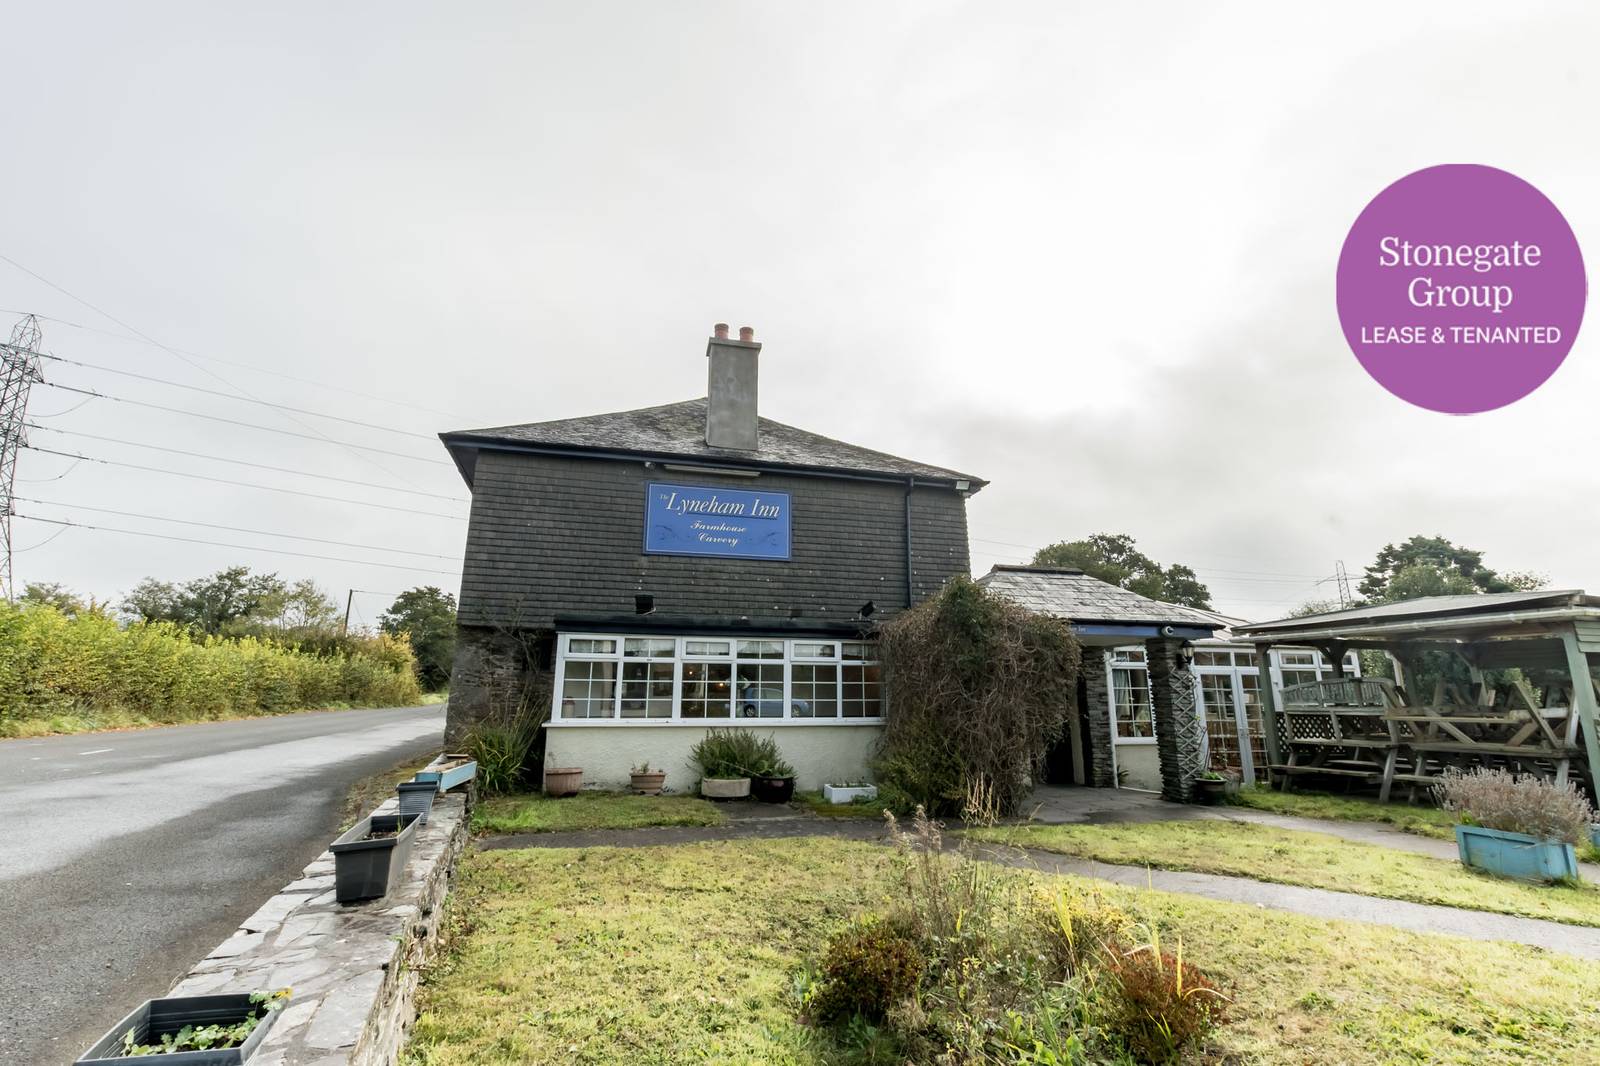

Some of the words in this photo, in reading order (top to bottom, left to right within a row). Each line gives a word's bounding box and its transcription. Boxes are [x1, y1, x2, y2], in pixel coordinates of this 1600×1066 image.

[666, 492, 744, 516] Lyneham
[751, 498, 780, 518] Inn
[690, 520, 747, 533] Farmhouse
[698, 532, 738, 548] Carvery
